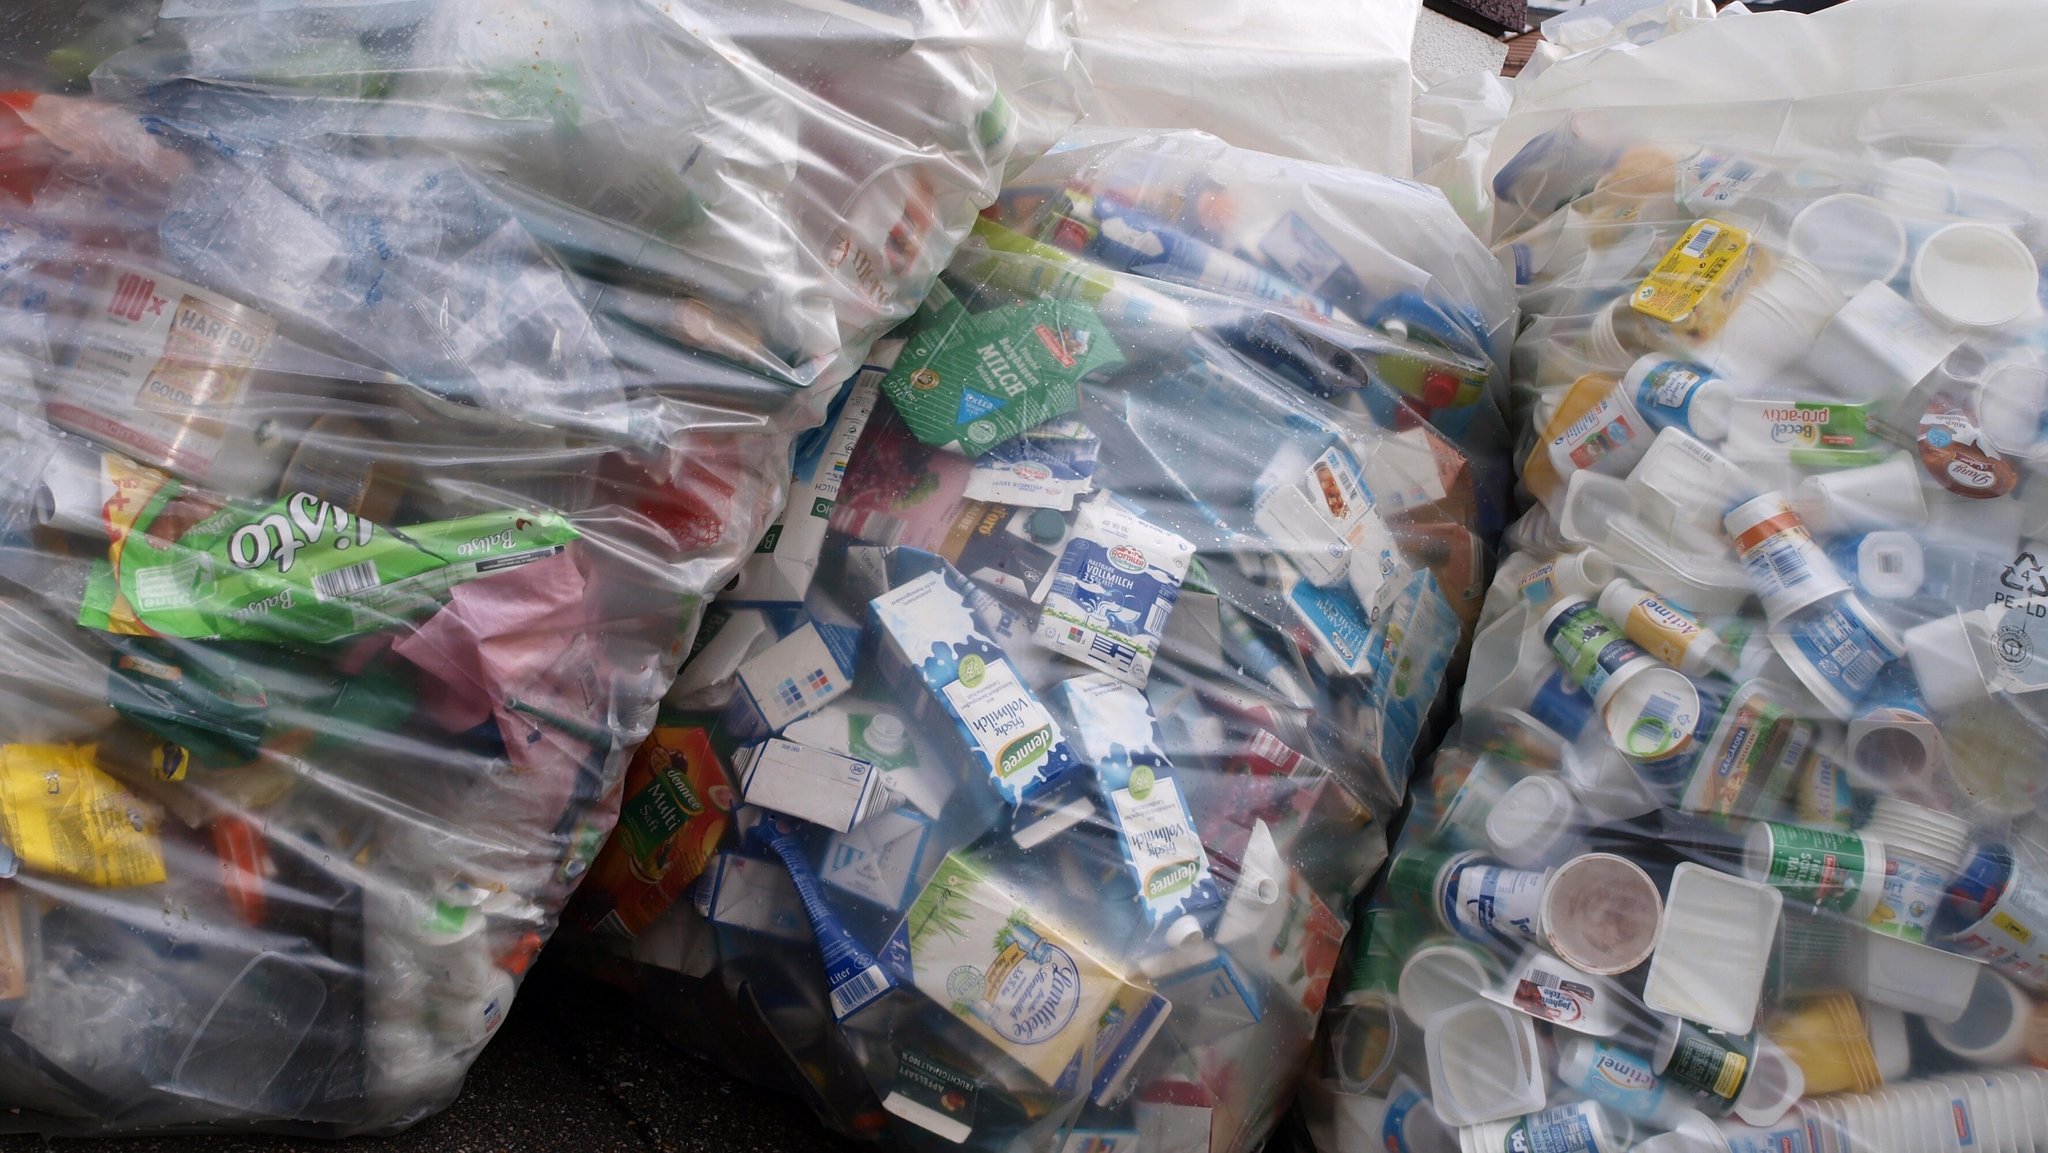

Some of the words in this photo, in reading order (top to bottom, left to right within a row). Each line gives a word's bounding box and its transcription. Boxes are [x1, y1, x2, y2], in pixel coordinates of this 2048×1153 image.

[179, 309, 256, 353] HARIBO
[976, 341, 1028, 398] MILCH
[998, 336, 1040, 388] Bergbauern
[1761, 407, 1828, 424] pro-activ
[1778, 423, 1812, 438] Becel
[1952, 462, 1992, 486] Dany
[457, 528, 517, 556] Balisto
[1086, 564, 1135, 591] VOLLMILCH
[2020, 569, 2031, 582] 4
[1637, 598, 1699, 635] Actimel
[972, 697, 1029, 732] Vollmilch
[995, 716, 1025, 737] frische
[1001, 727, 1051, 773] dennree
[667, 769, 701, 810] dennree
[639, 804, 658, 833] Saft
[649, 783, 681, 832] Multi
[1129, 822, 1184, 851] Vollmilch
[1149, 862, 1198, 896] dennree
[831, 967, 851, 986] Liter
[1009, 967, 1049, 1020] Landmilch
[1013, 963, 1074, 1038] Landliebe
[1543, 989, 1562, 1000] Ecke
[908, 1055, 922, 1068] 100
[921, 1060, 975, 1092] FRUCHTGEHALT
[900, 1064, 945, 1094] APFELSAFT
